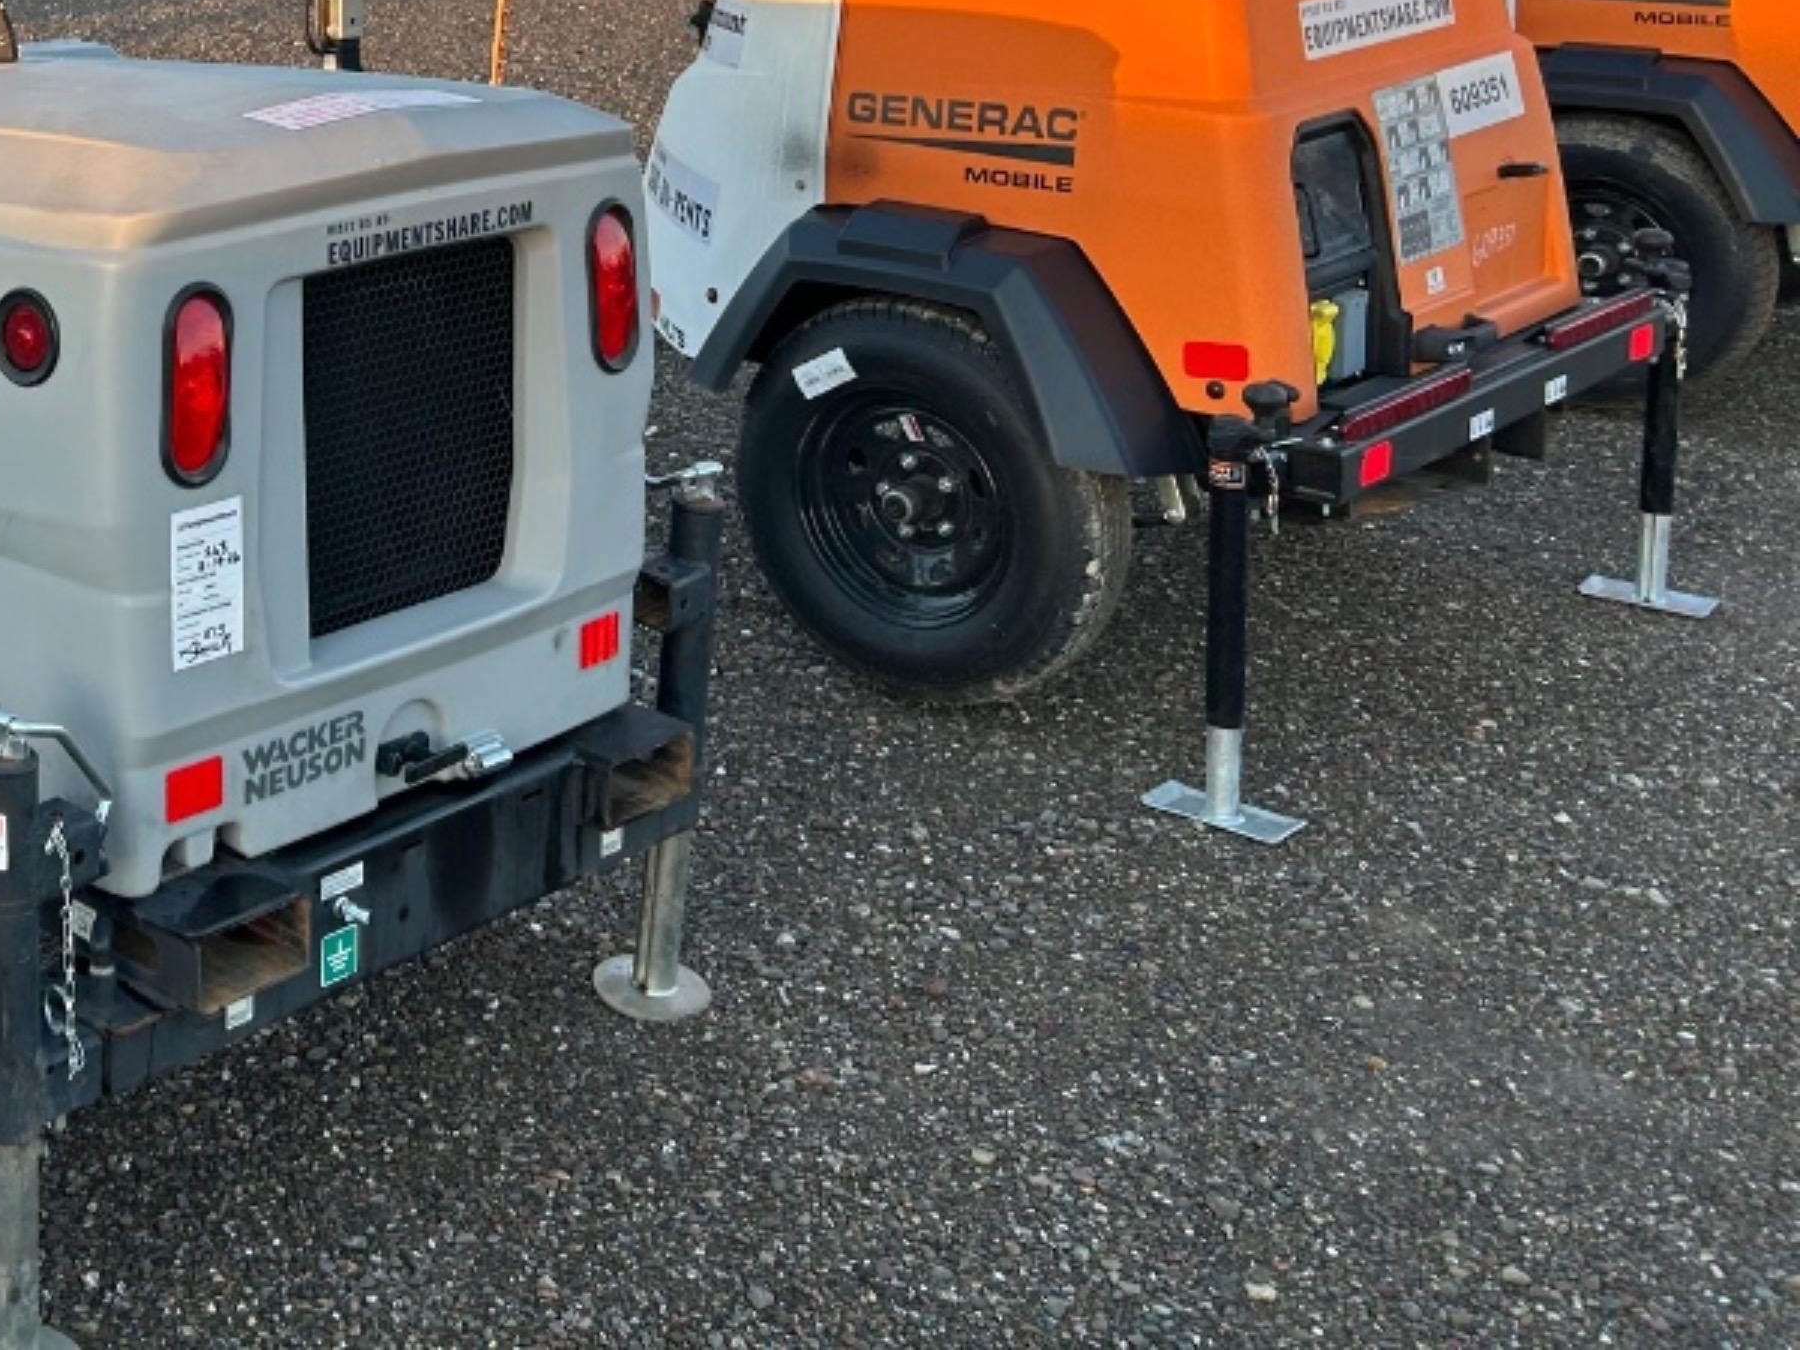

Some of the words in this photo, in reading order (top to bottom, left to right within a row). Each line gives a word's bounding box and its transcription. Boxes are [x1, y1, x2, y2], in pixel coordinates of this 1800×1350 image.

[1633, 10, 1732, 27] MOBILE
[848, 91, 1078, 141] GENERAC
[1449, 74, 1510, 115] 609351
[964, 166, 1074, 193] MOBILE
[327, 200, 533, 267] EQUIPMENTSHARE.COM
[242, 710, 365, 775] WACKER
[244, 738, 366, 805] NEUSON
